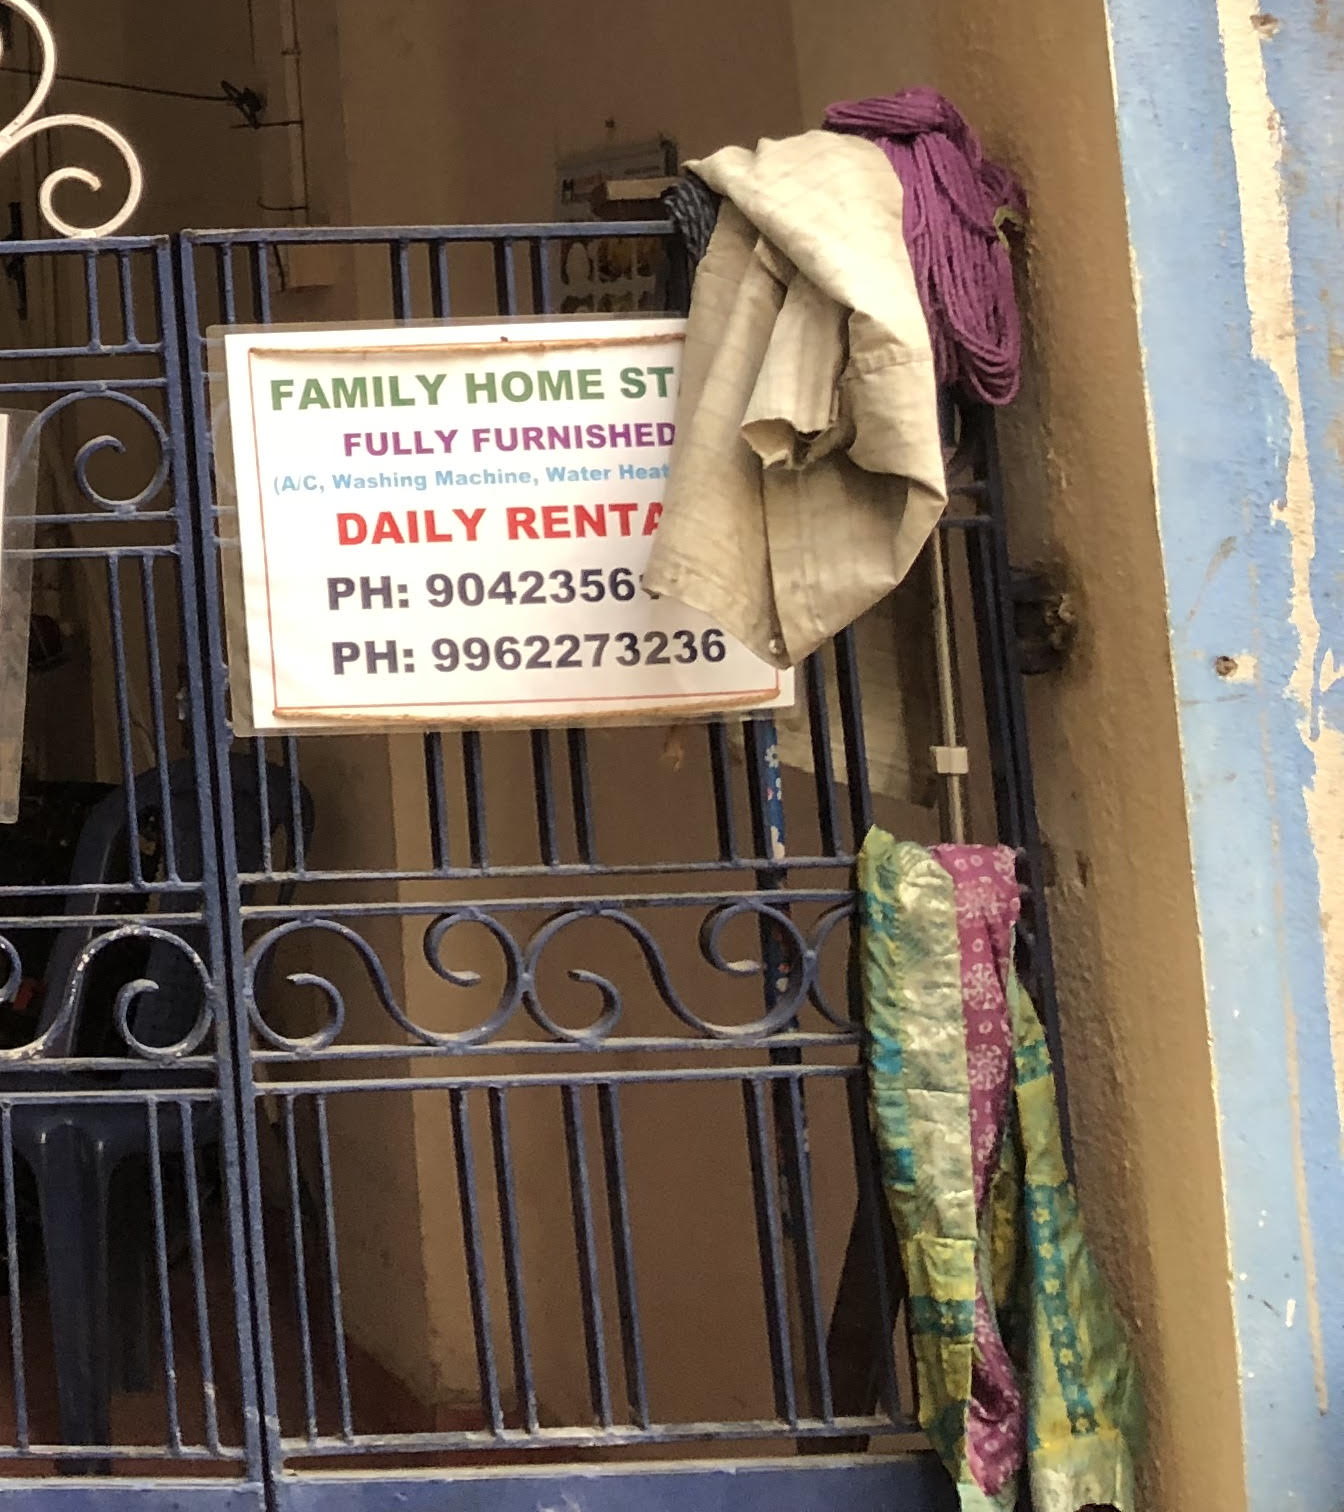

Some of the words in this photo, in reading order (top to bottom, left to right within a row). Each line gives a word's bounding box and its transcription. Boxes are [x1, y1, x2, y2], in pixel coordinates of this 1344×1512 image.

[270, 373, 446, 411] FAMILY
[466, 368, 605, 404] HOME
[619, 366, 674, 399] ST
[343, 429, 458, 457] FULLY
[472, 422, 676, 453] FURNISHED
[331, 472, 428, 491] Washing
[435, 468, 540, 487] Machine,
[545, 466, 612, 482] Water
[618, 463, 670, 480] Heat
[336, 507, 486, 546] DAILY
[506, 502, 664, 541] RENTA
[327, 575, 409, 611] PH:
[426, 567, 661, 609] 9042356
[332, 639, 415, 675] PH:
[431, 628, 727, 673] 9962273236
